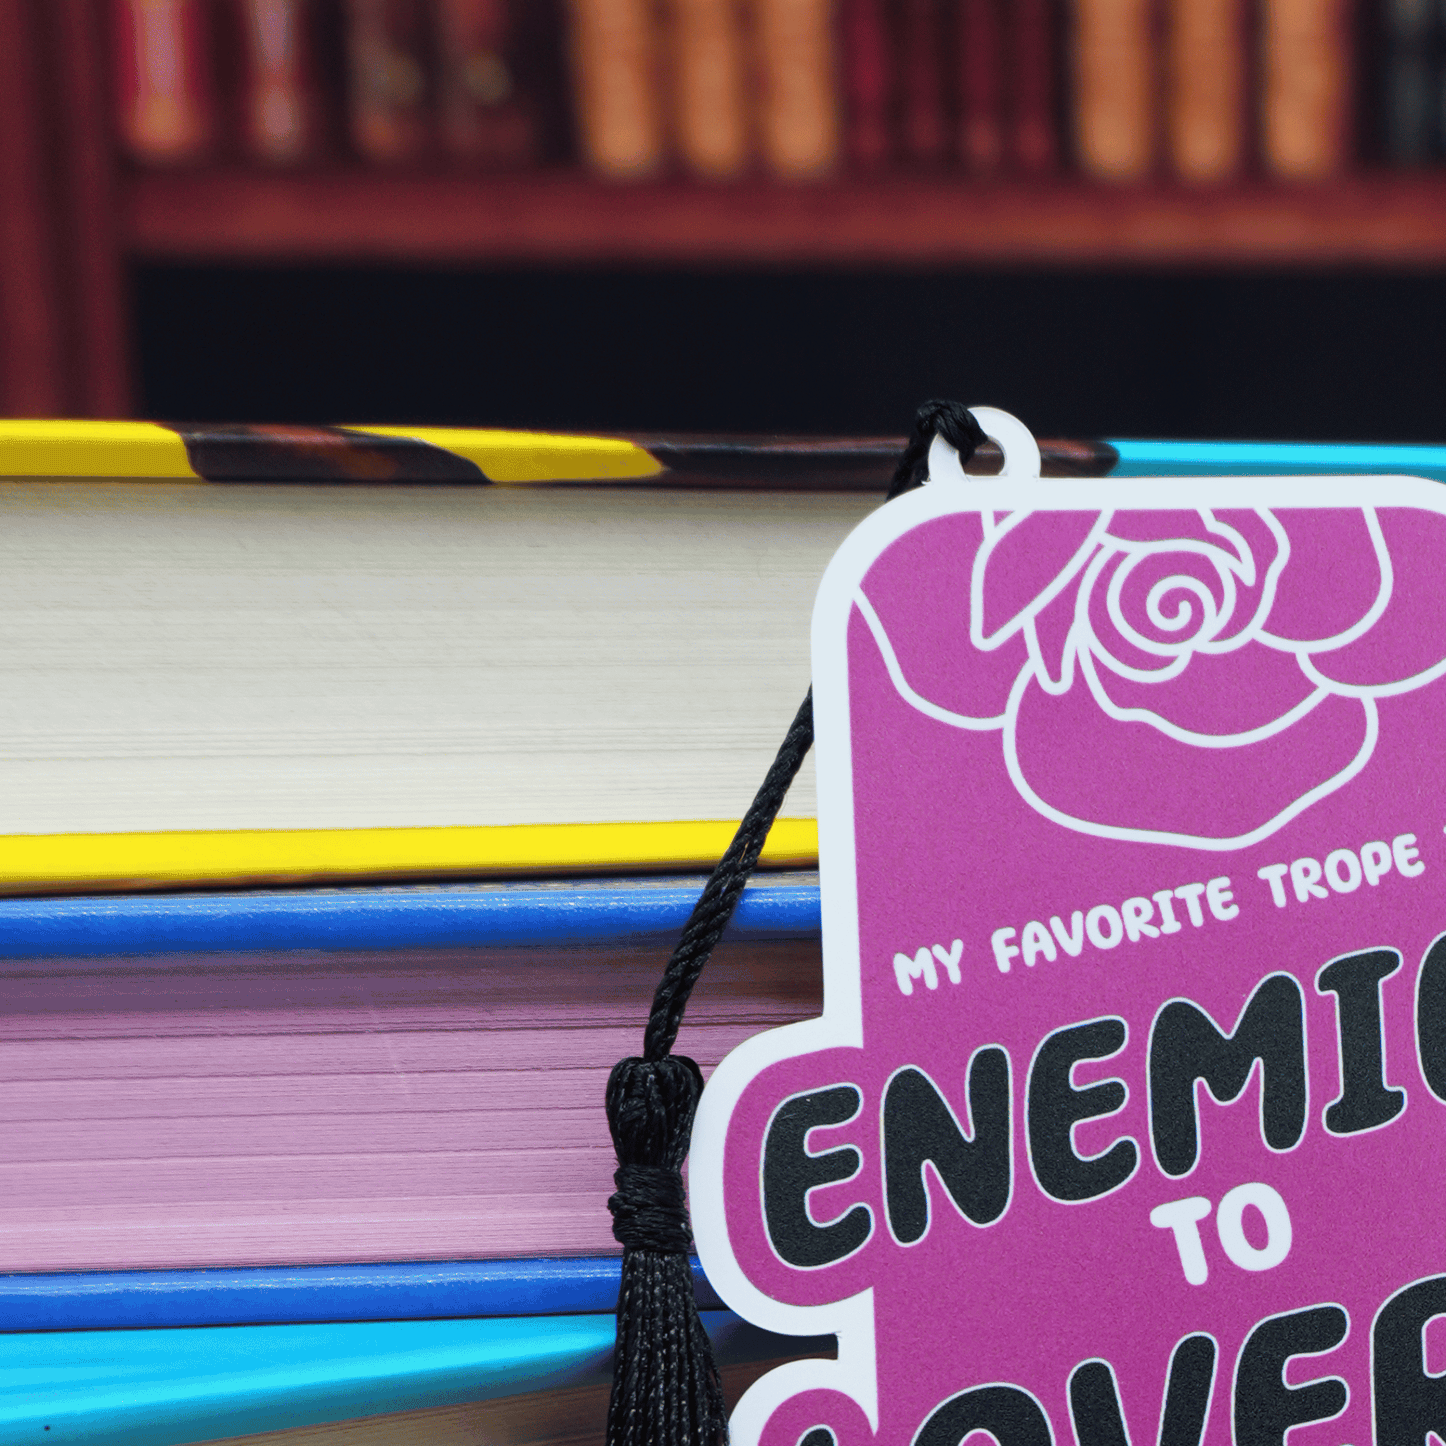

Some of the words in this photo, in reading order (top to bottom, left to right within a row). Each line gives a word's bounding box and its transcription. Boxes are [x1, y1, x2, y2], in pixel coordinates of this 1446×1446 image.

[893, 939, 964, 996] MY
[991, 876, 1239, 973] FAVORITE
[1258, 832, 1423, 908] TROPE
[1149, 1182, 1292, 1286] TO
